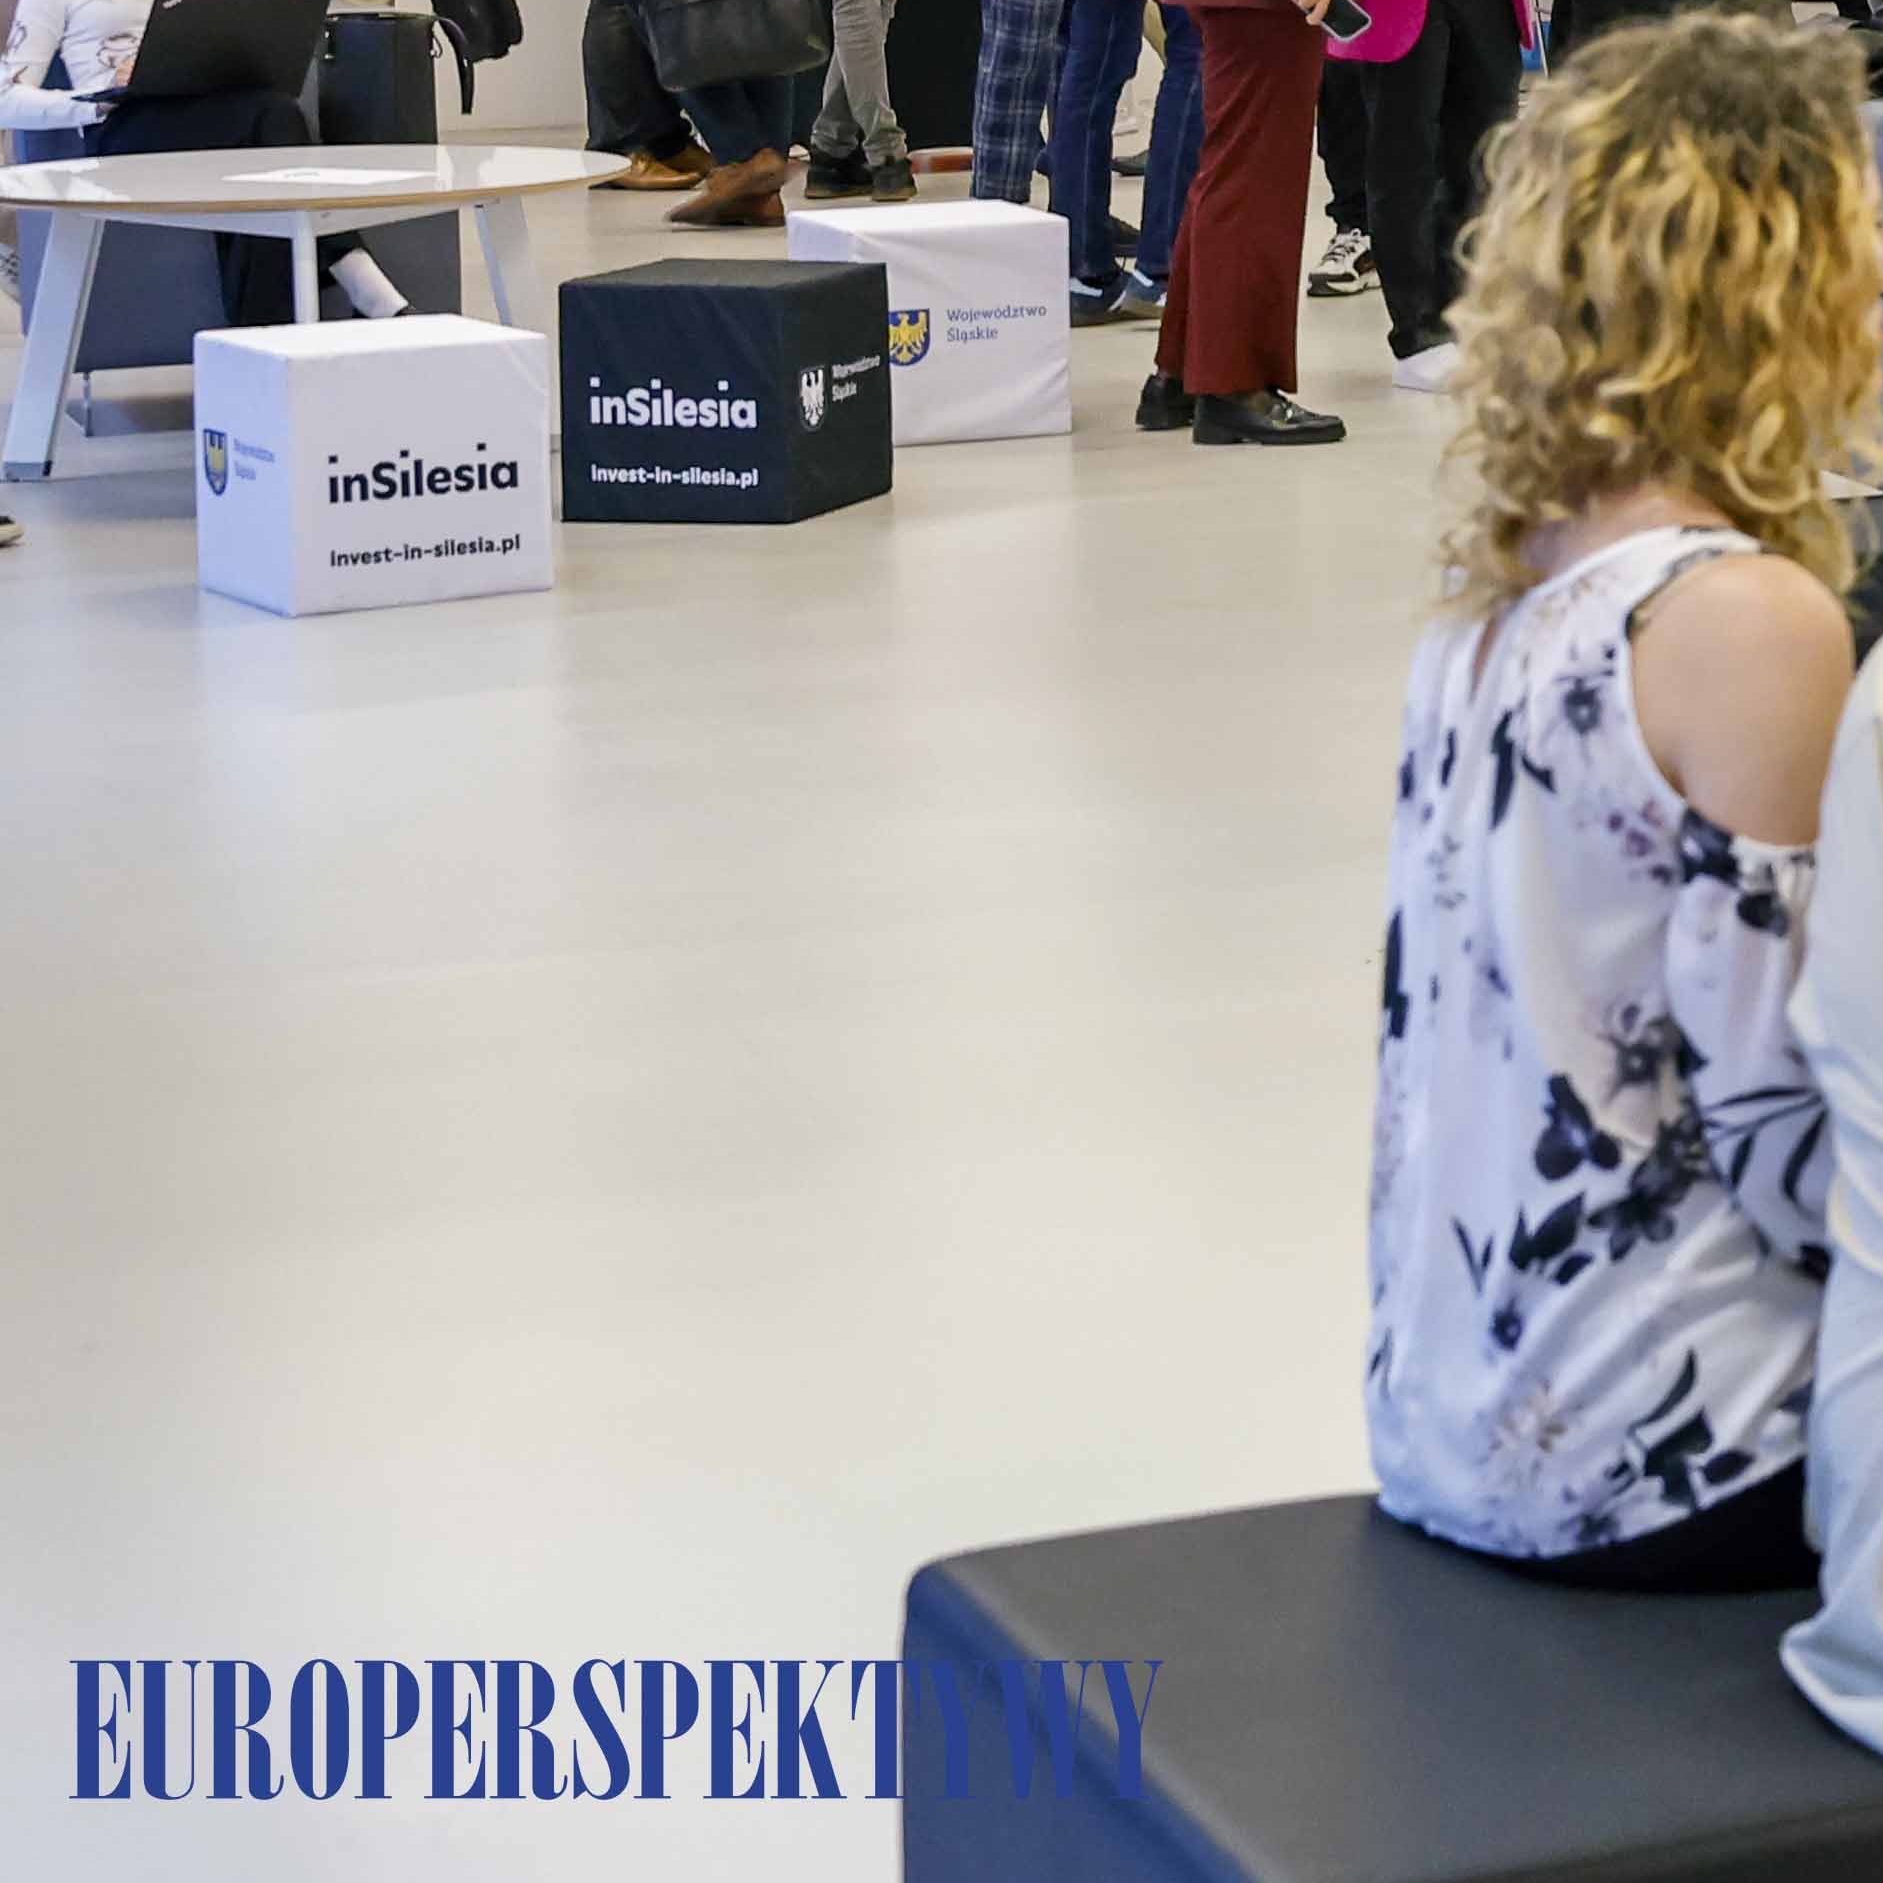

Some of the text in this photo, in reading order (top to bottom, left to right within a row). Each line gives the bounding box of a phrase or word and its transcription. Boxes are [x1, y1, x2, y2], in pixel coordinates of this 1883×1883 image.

[946, 304, 1048, 324] Województwo
[946, 326, 999, 344] Śląskie
[590, 376, 758, 429] inSilesia
[328, 442, 520, 504] inSilesia
[591, 463, 759, 490] invest-in-silesia.pl
[330, 533, 521, 568] invest-in-silesia.pl
